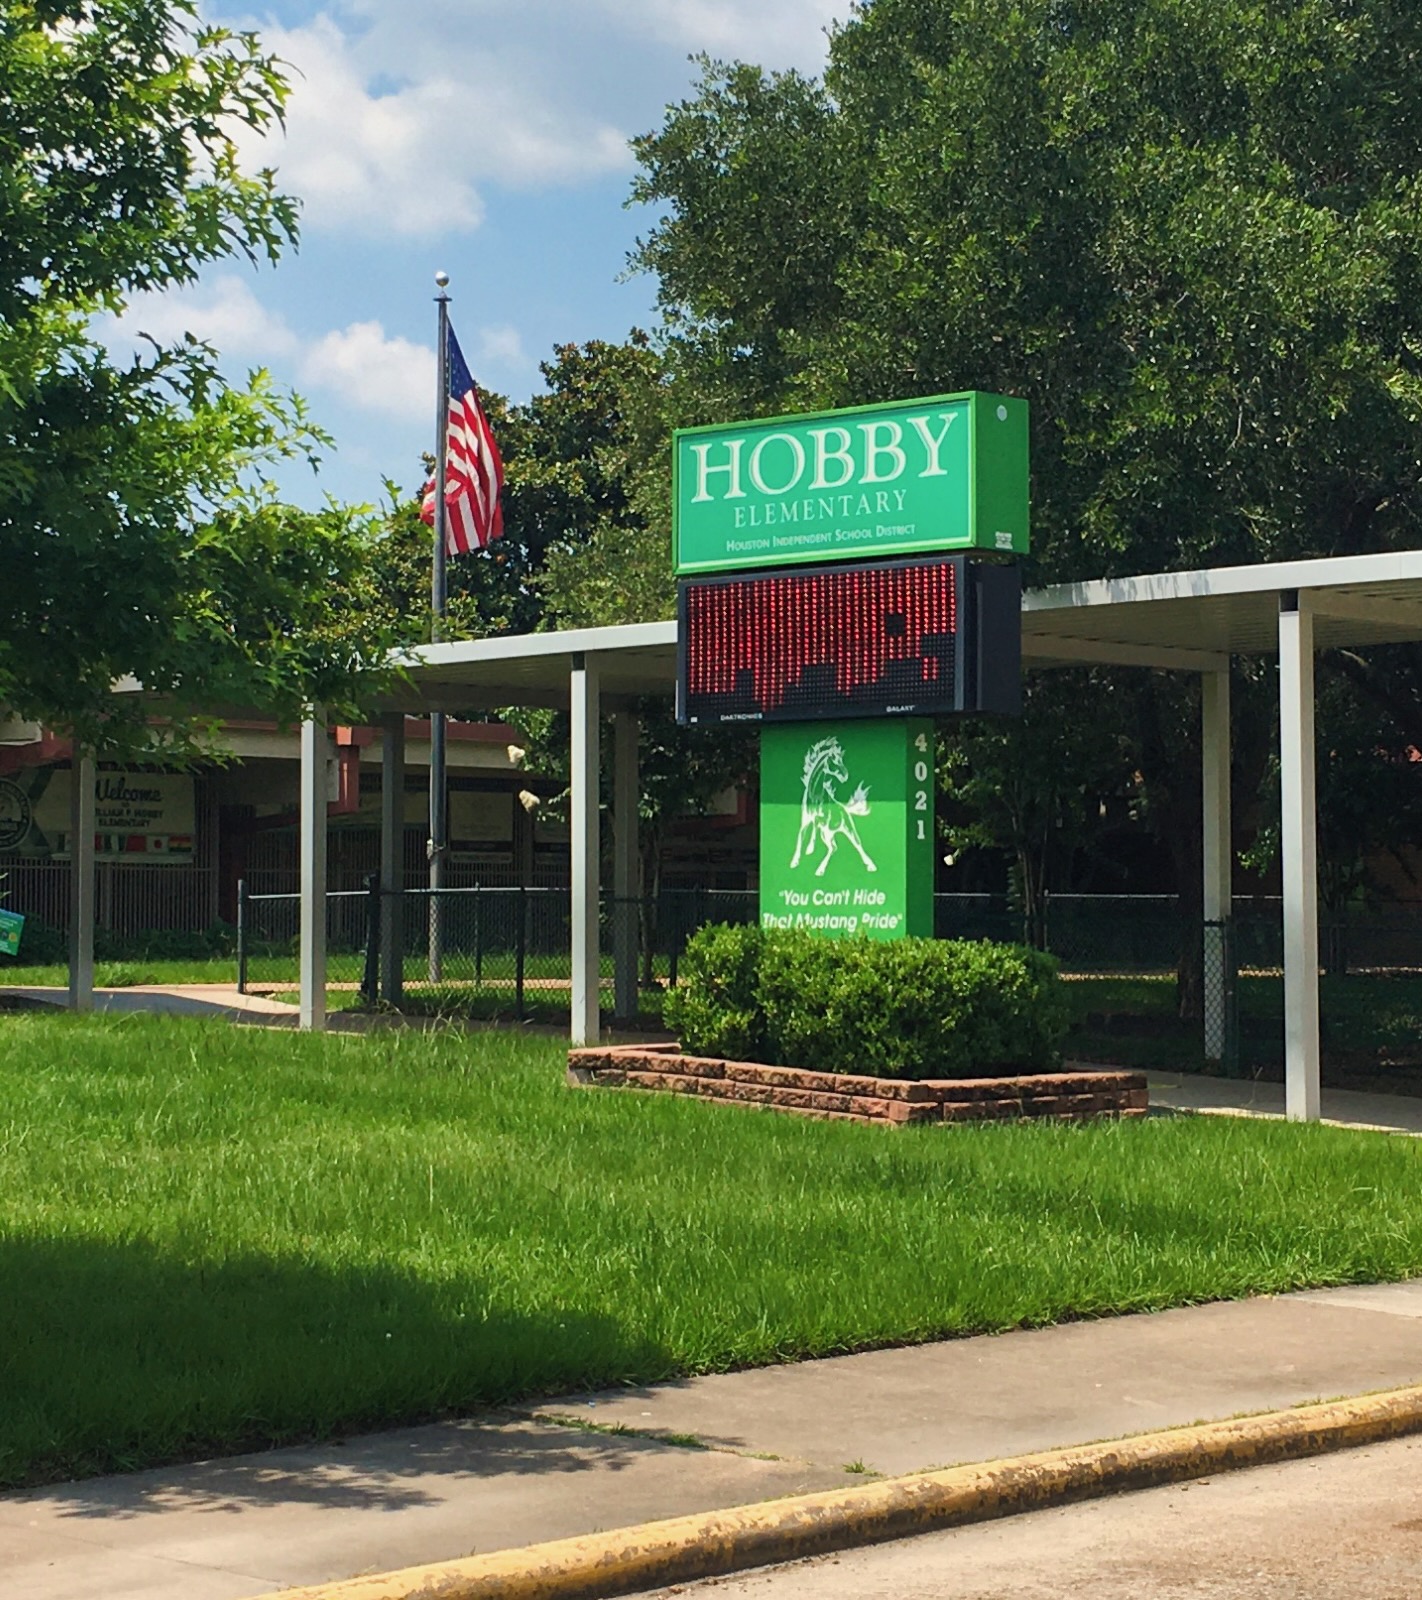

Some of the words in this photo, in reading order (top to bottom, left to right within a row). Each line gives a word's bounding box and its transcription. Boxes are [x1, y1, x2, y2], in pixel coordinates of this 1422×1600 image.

[689, 411, 959, 504] HOBBY
[733, 488, 907, 529] ELEMENTARY
[726, 538, 770, 552] HOUSTON
[772, 532, 832, 547] INDEPENDENT
[835, 527, 873, 541] SCHOOL
[876, 524, 916, 537] DISTRICT
[778, 889, 809, 906] "You
[812, 889, 850, 906] Can't
[853, 889, 886, 906] Hide
[796, 912, 857, 933] Mustang
